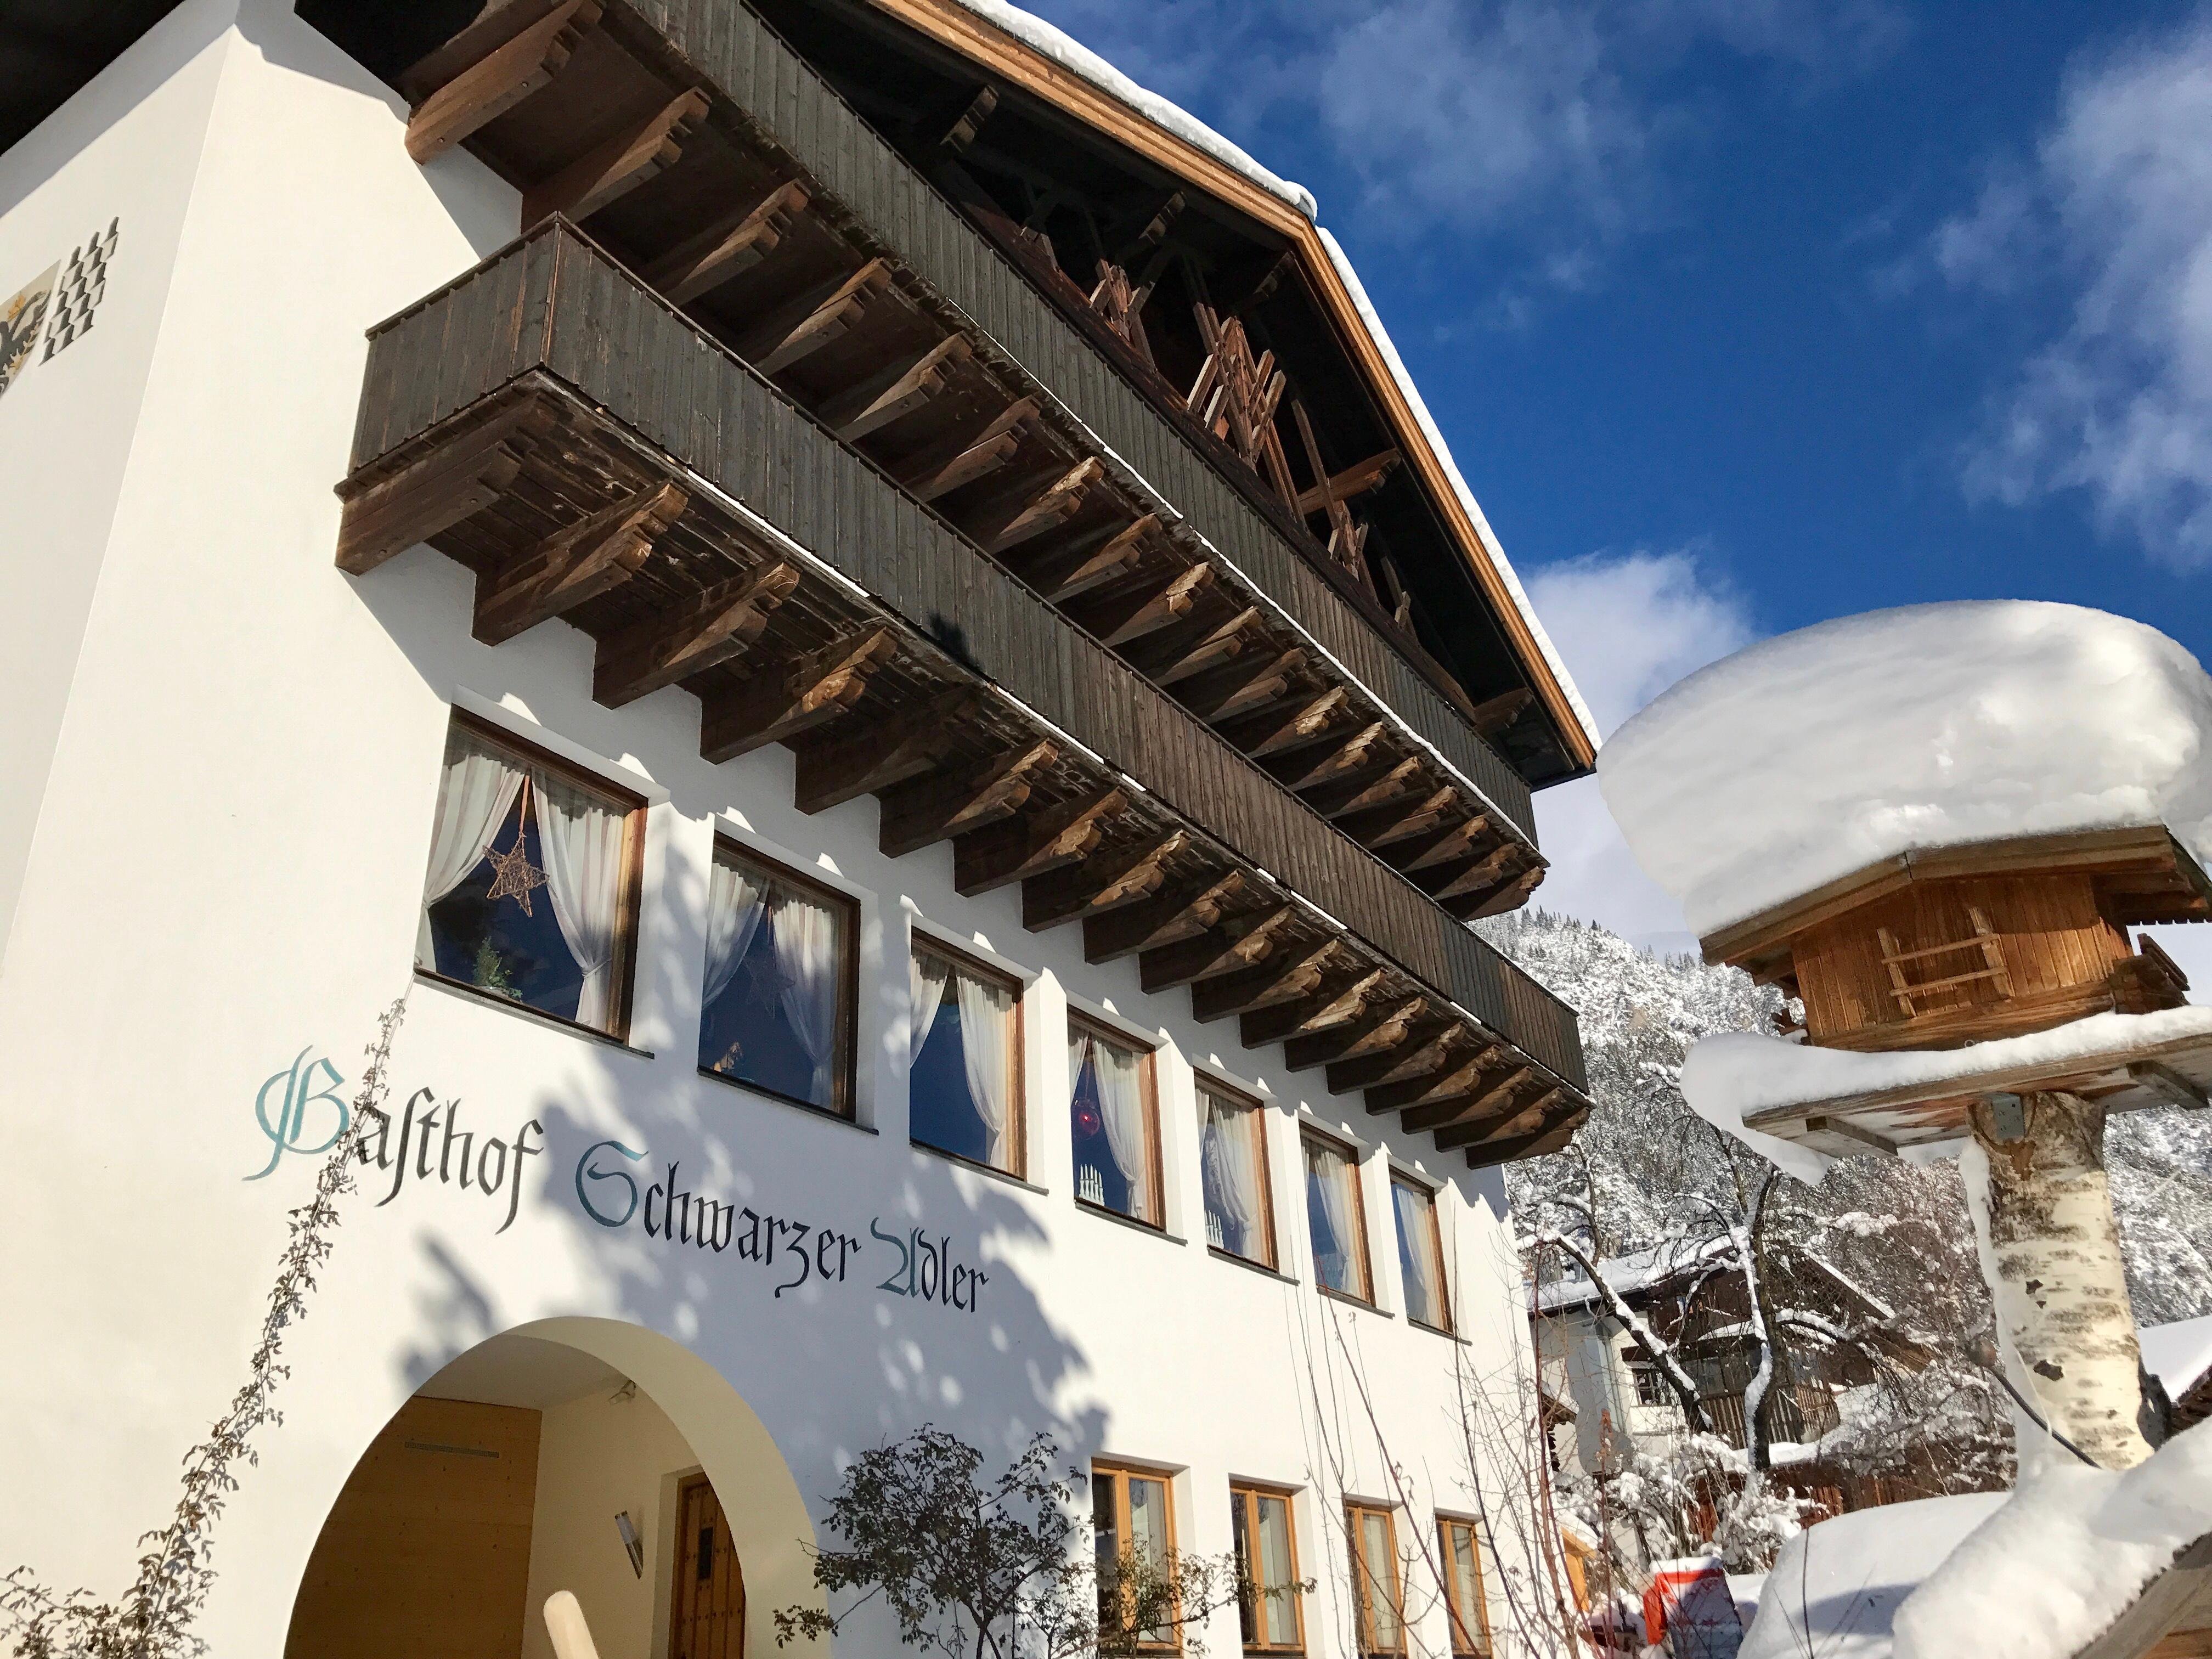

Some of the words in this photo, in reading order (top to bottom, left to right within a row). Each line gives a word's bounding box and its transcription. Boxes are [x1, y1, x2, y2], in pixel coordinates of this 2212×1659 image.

[241, 1045, 544, 1235] Gasthof
[575, 1140, 862, 1298] Schwarzer
[870, 1217, 989, 1313] Adler
